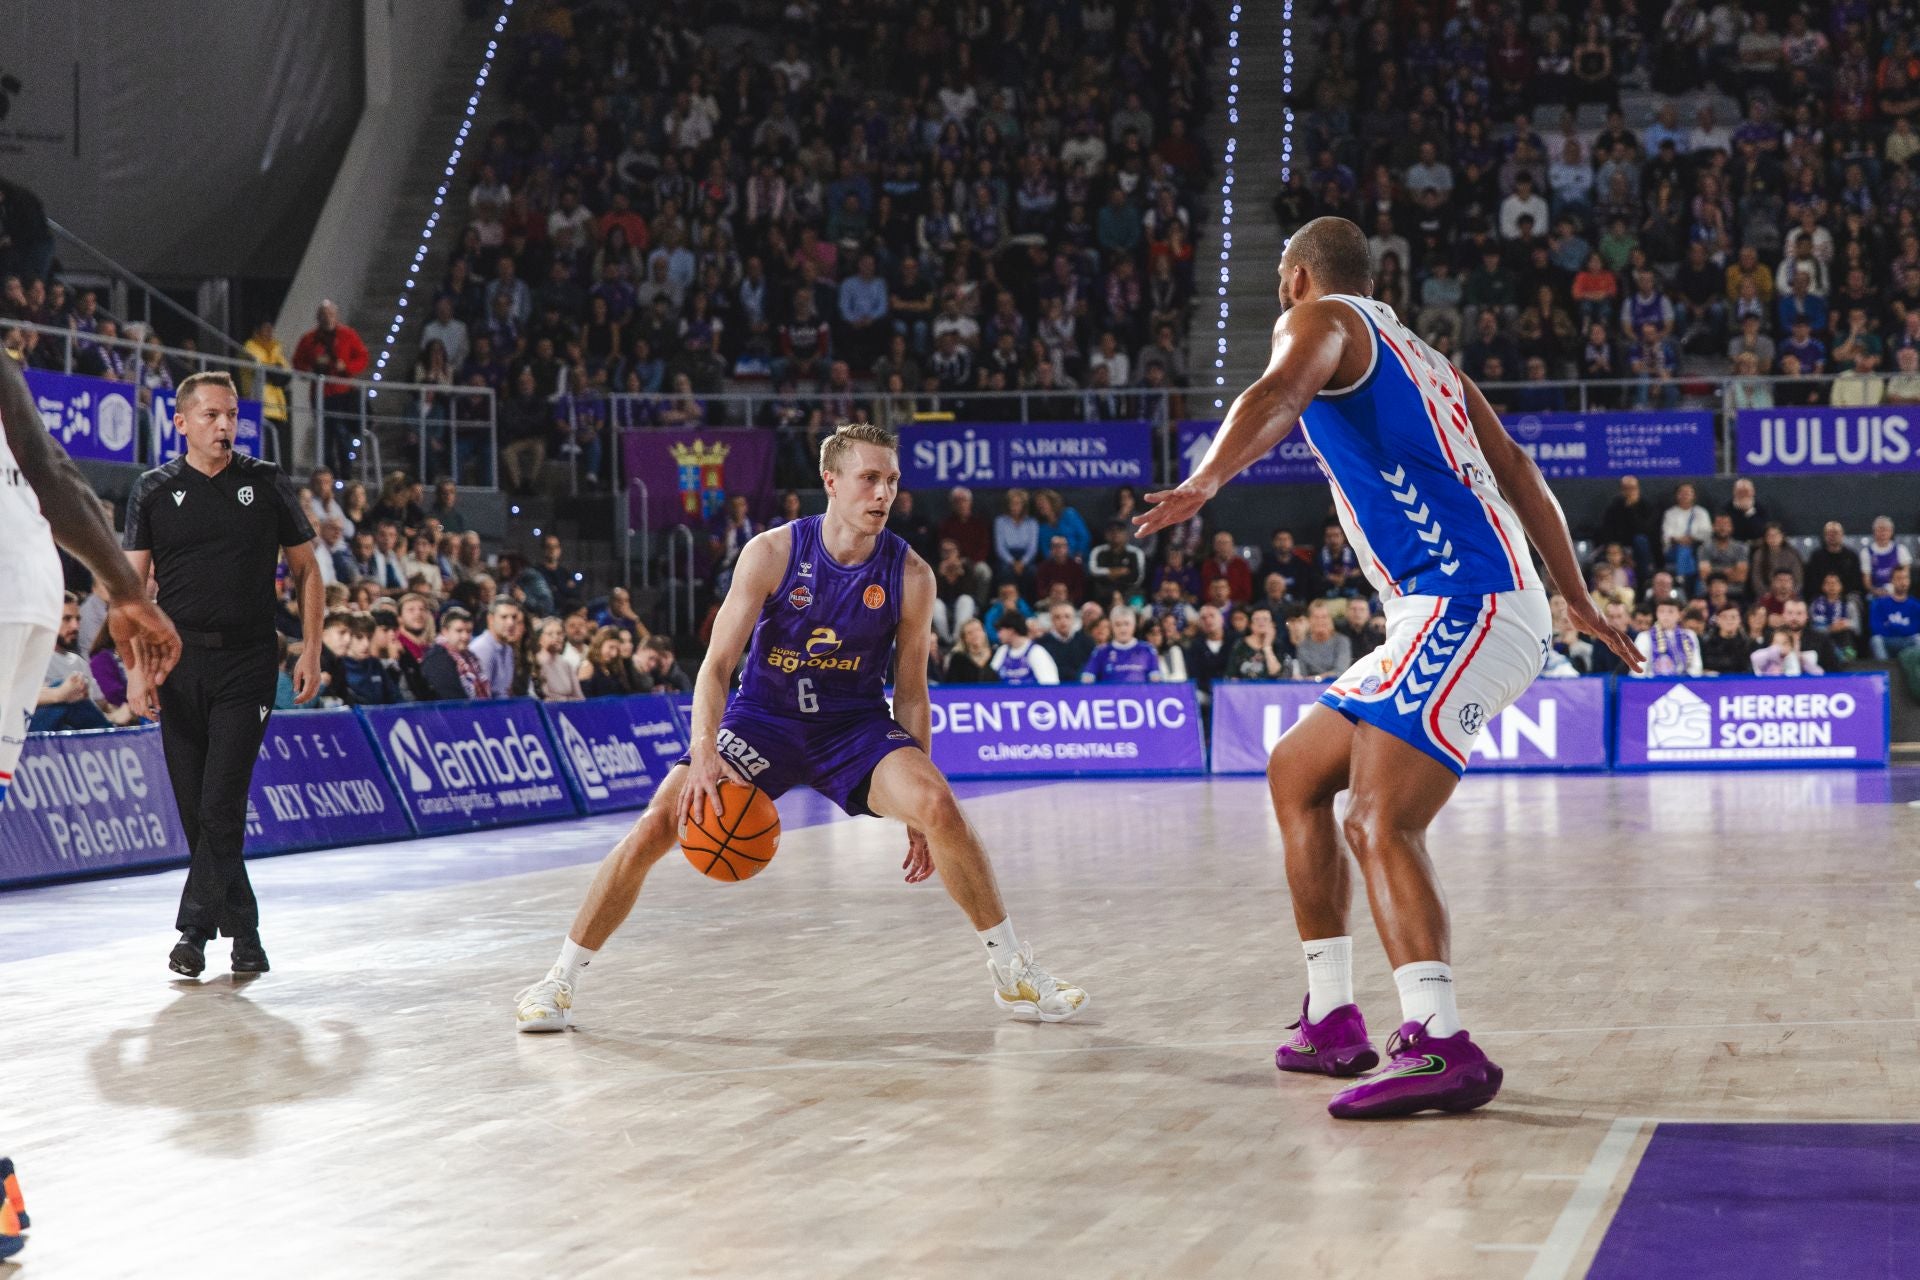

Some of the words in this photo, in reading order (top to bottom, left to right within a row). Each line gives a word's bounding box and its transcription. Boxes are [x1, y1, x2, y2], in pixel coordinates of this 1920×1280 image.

[1009, 437, 1107, 457] SABORES
[1746, 414, 1911, 466] JULUIS
[1010, 459, 1140, 479] PALENTINOS
[797, 677, 820, 713] 6
[1719, 692, 1856, 720] HERRERO
[930, 697, 1186, 733] DENTOMEDIC
[978, 742, 1054, 761] CLÍNICAS
[1054, 741, 1139, 759] DENTALES
[1719, 720, 1832, 748] SOBRIN
[416, 717, 554, 789] lambda
[263, 783, 310, 821] REY
[305, 779, 385, 818] SANCHO
[47, 803, 167, 859] Palencia
